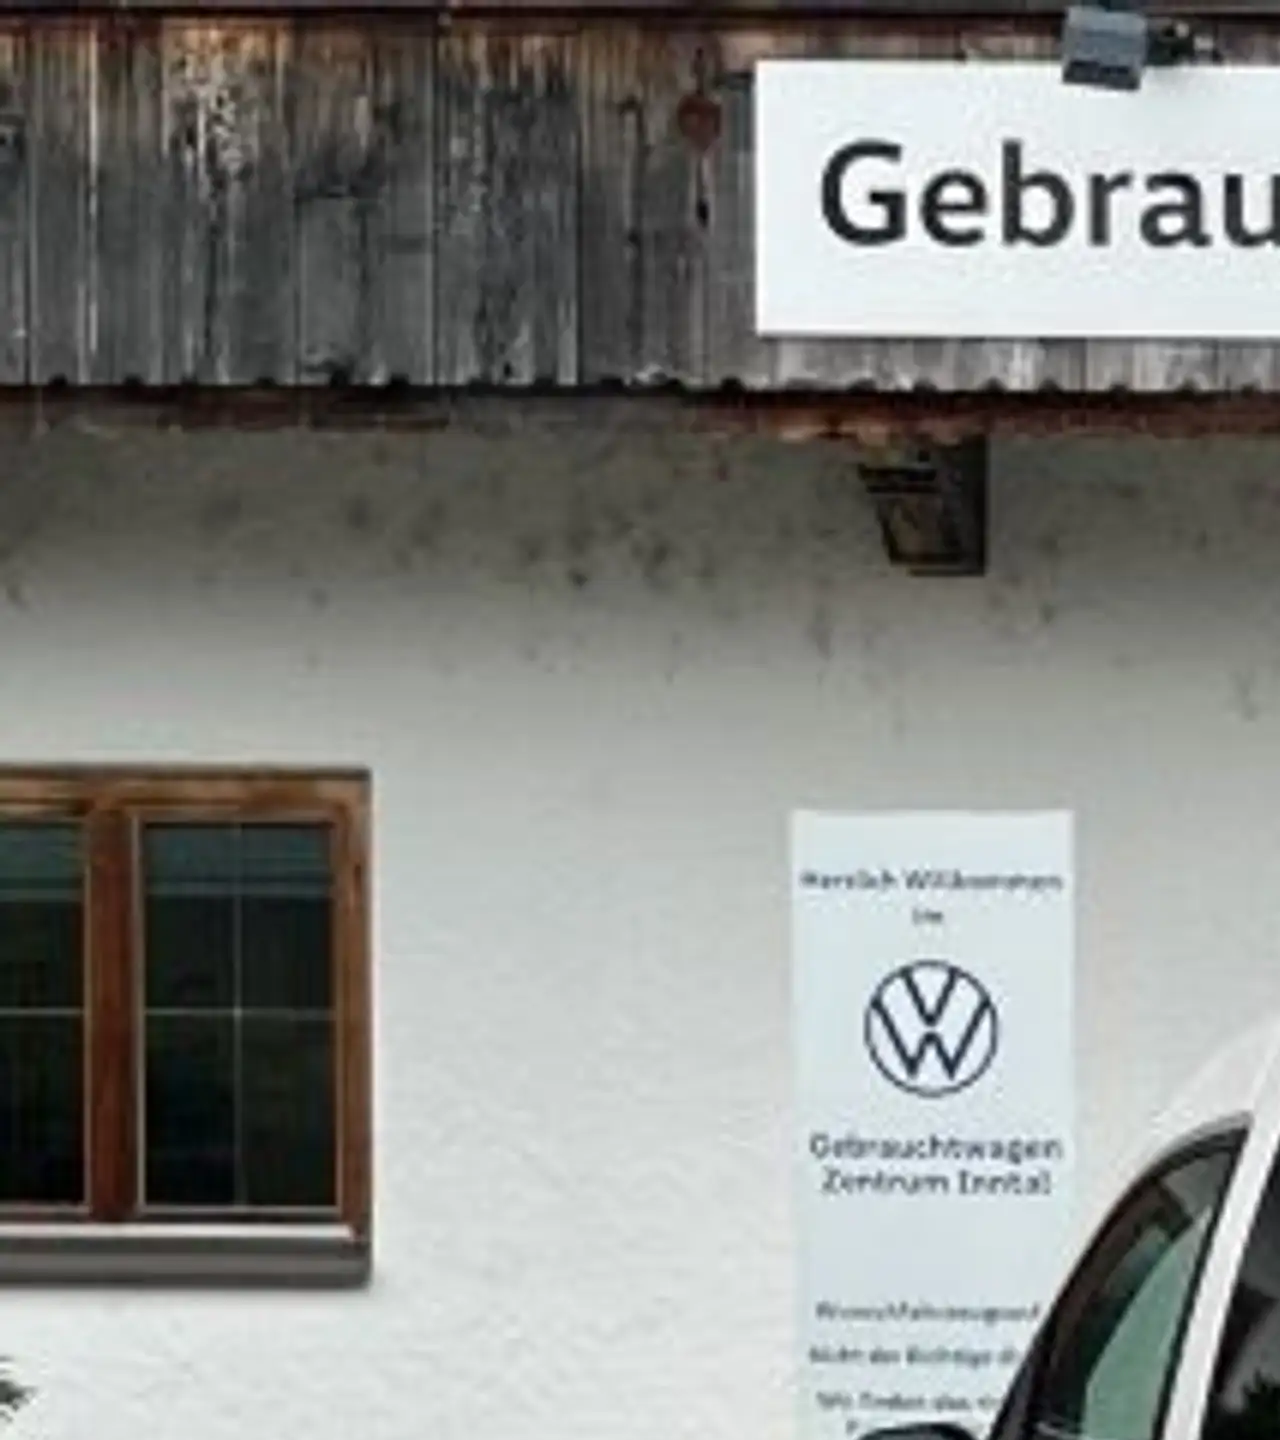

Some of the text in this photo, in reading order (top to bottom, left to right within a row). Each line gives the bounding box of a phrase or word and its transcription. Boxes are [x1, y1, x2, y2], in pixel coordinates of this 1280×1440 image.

[808, 1131, 1064, 1166] Gebrauchtwagen
[821, 1166, 1052, 1196] Zentrum Inntal
